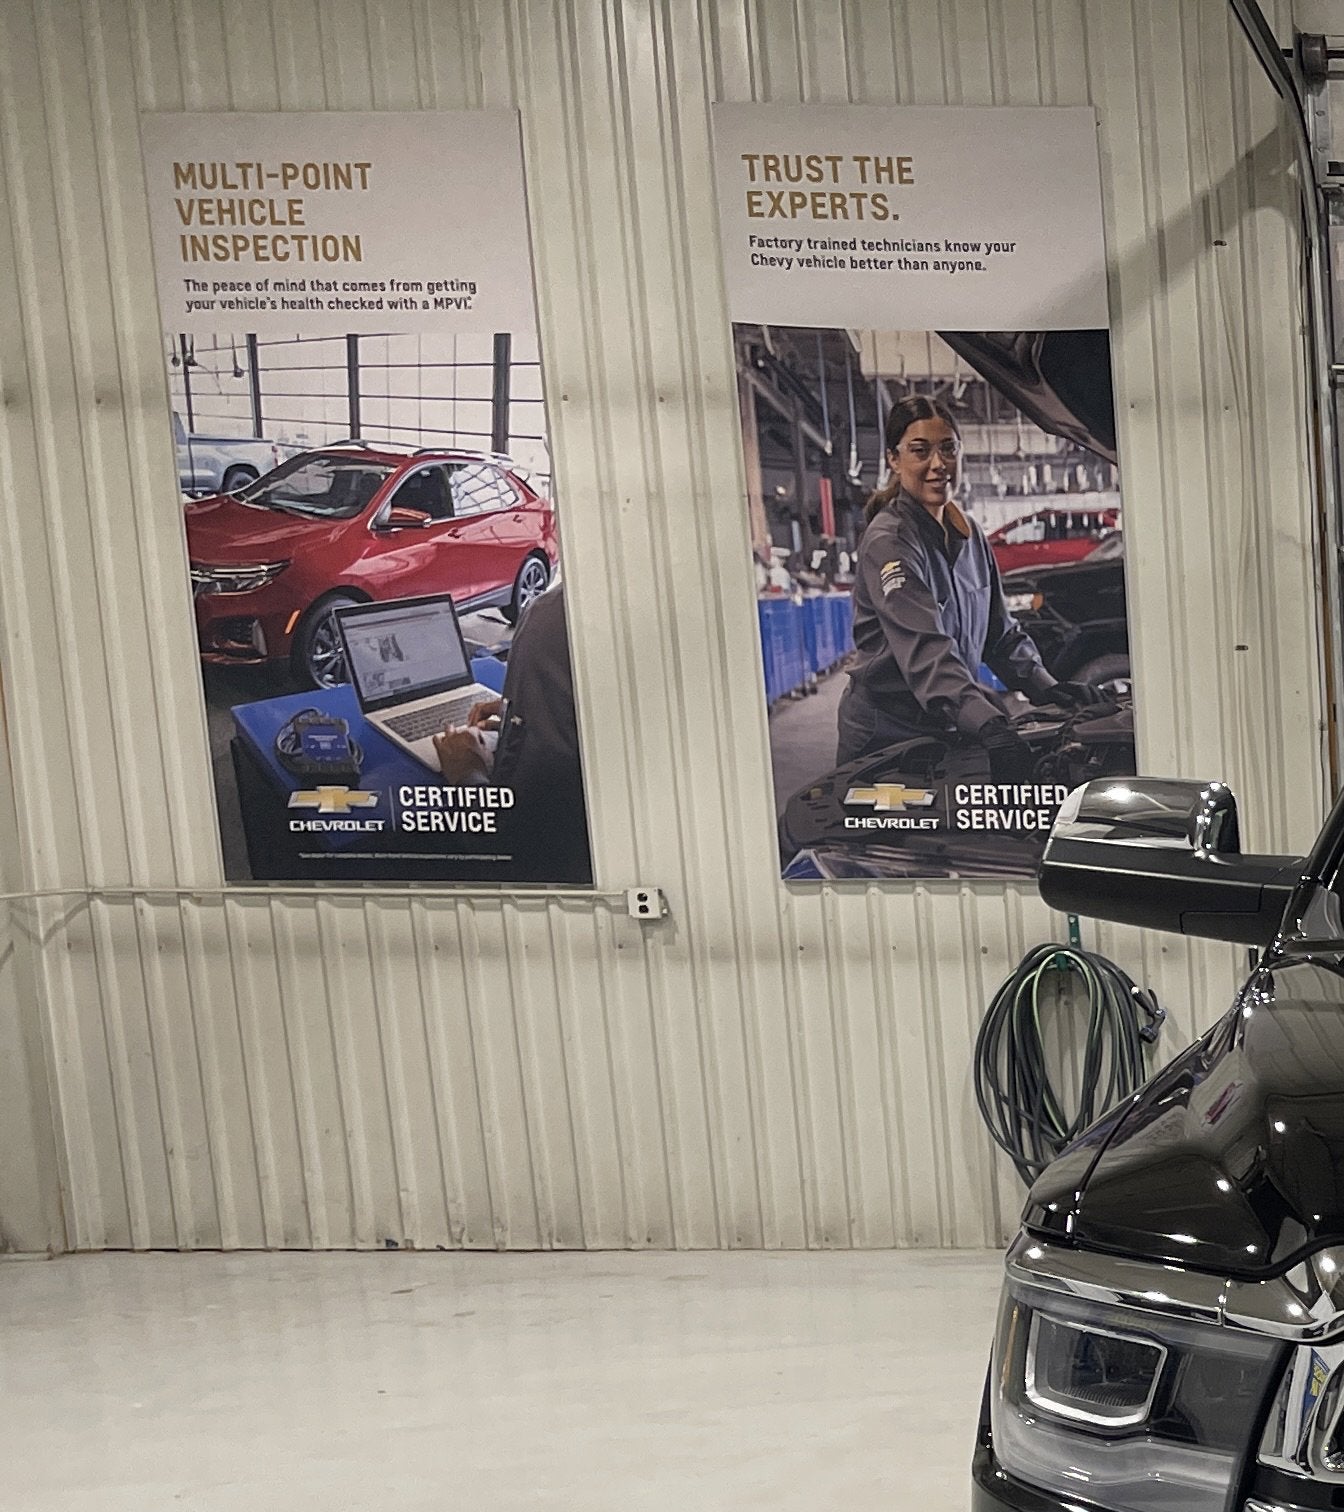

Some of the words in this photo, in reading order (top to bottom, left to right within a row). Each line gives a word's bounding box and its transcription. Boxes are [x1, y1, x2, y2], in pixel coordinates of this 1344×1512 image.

[173, 161, 372, 190] MULTI-POINT
[741, 154, 843, 184] TRUST
[853, 156, 915, 185] THE
[175, 198, 305, 226] VEHICLE
[745, 191, 900, 221] EXPERTS.
[180, 234, 362, 263] INSPECTION
[749, 235, 802, 252] Factory
[807, 237, 857, 251] trained
[860, 238, 941, 253] technicians
[945, 239, 981, 253] know
[985, 241, 1016, 256] your
[751, 253, 793, 270] Chevy
[797, 254, 846, 269] vehicle
[850, 256, 893, 271] better
[897, 257, 928, 271] than
[933, 259, 986, 274] anyone.
[183, 278, 208, 292] The
[213, 280, 251, 295] peace
[255, 279, 269, 292] of
[273, 278, 306, 292] mind
[310, 279, 338, 292] that
[342, 281, 386, 292] comes
[390, 278, 423, 292] from
[427, 279, 477, 295] getting
[185, 299, 215, 313] your
[220, 297, 277, 310] vehicle's
[281, 297, 323, 310] health
[327, 297, 383, 310] checked
[387, 297, 418, 310] with
[422, 300, 429, 310] a
[399, 786, 514, 808] CERTIFIED
[955, 784, 1068, 805] CERTIFIED
[289, 820, 385, 832] CHEVROLET
[401, 811, 497, 833] SERVICE
[844, 816, 939, 829] CHEVROLET
[956, 809, 1050, 830] SERVICE
